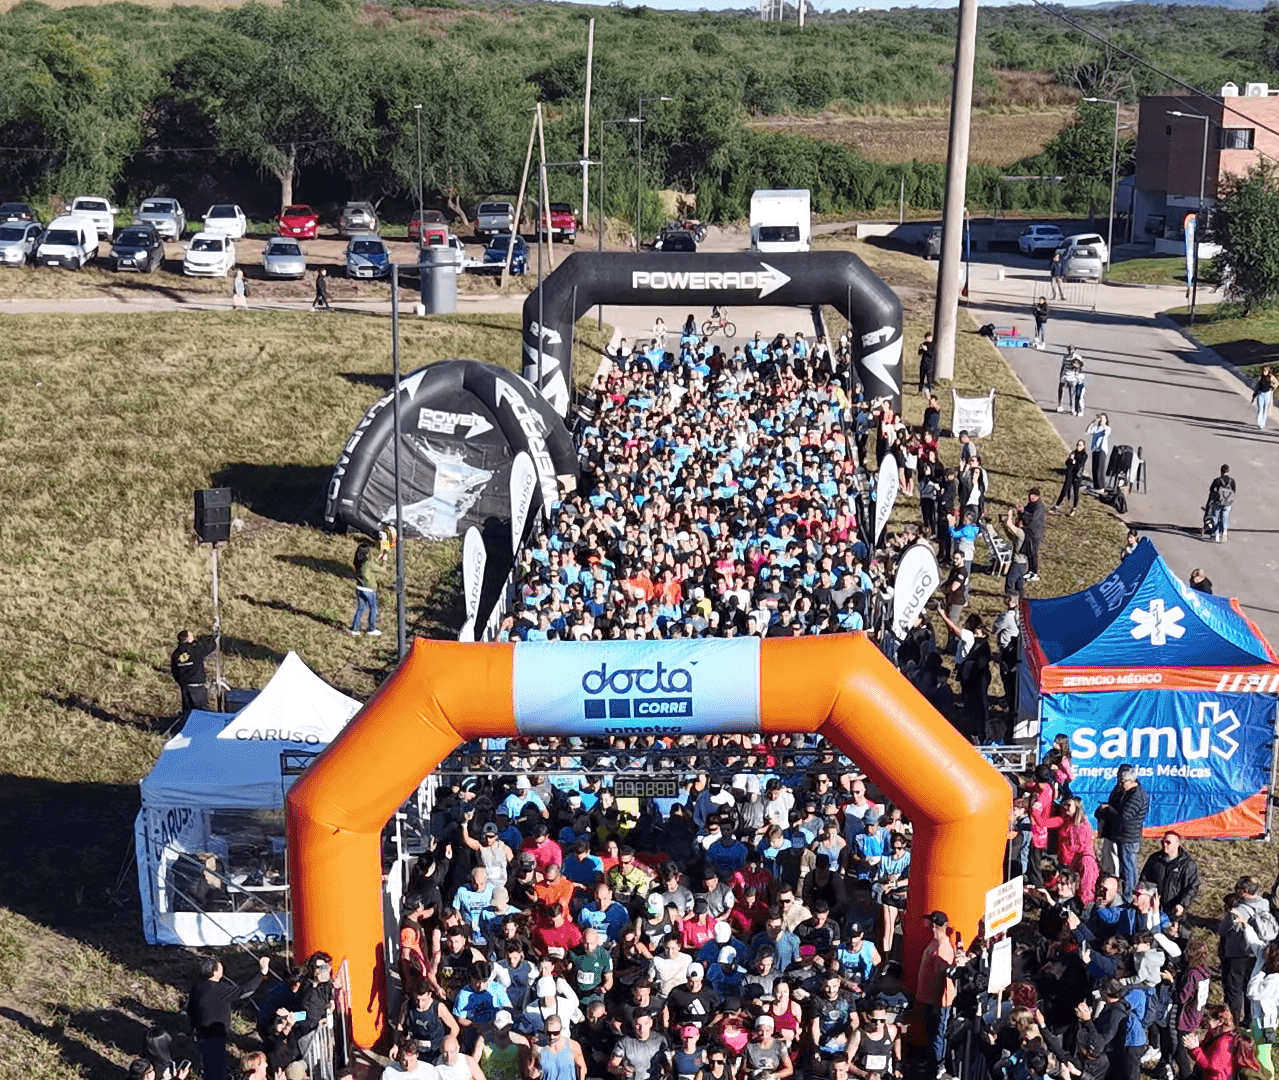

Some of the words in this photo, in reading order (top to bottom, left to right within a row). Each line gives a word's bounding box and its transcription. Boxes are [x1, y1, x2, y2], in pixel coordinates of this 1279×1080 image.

[632, 271, 770, 290] POWERADE
[638, 701, 687, 714] CORRE
[235, 728, 320, 746] CARUSO
[1071, 726, 1210, 760] samu
[1161, 764, 1211, 778] Médicas
